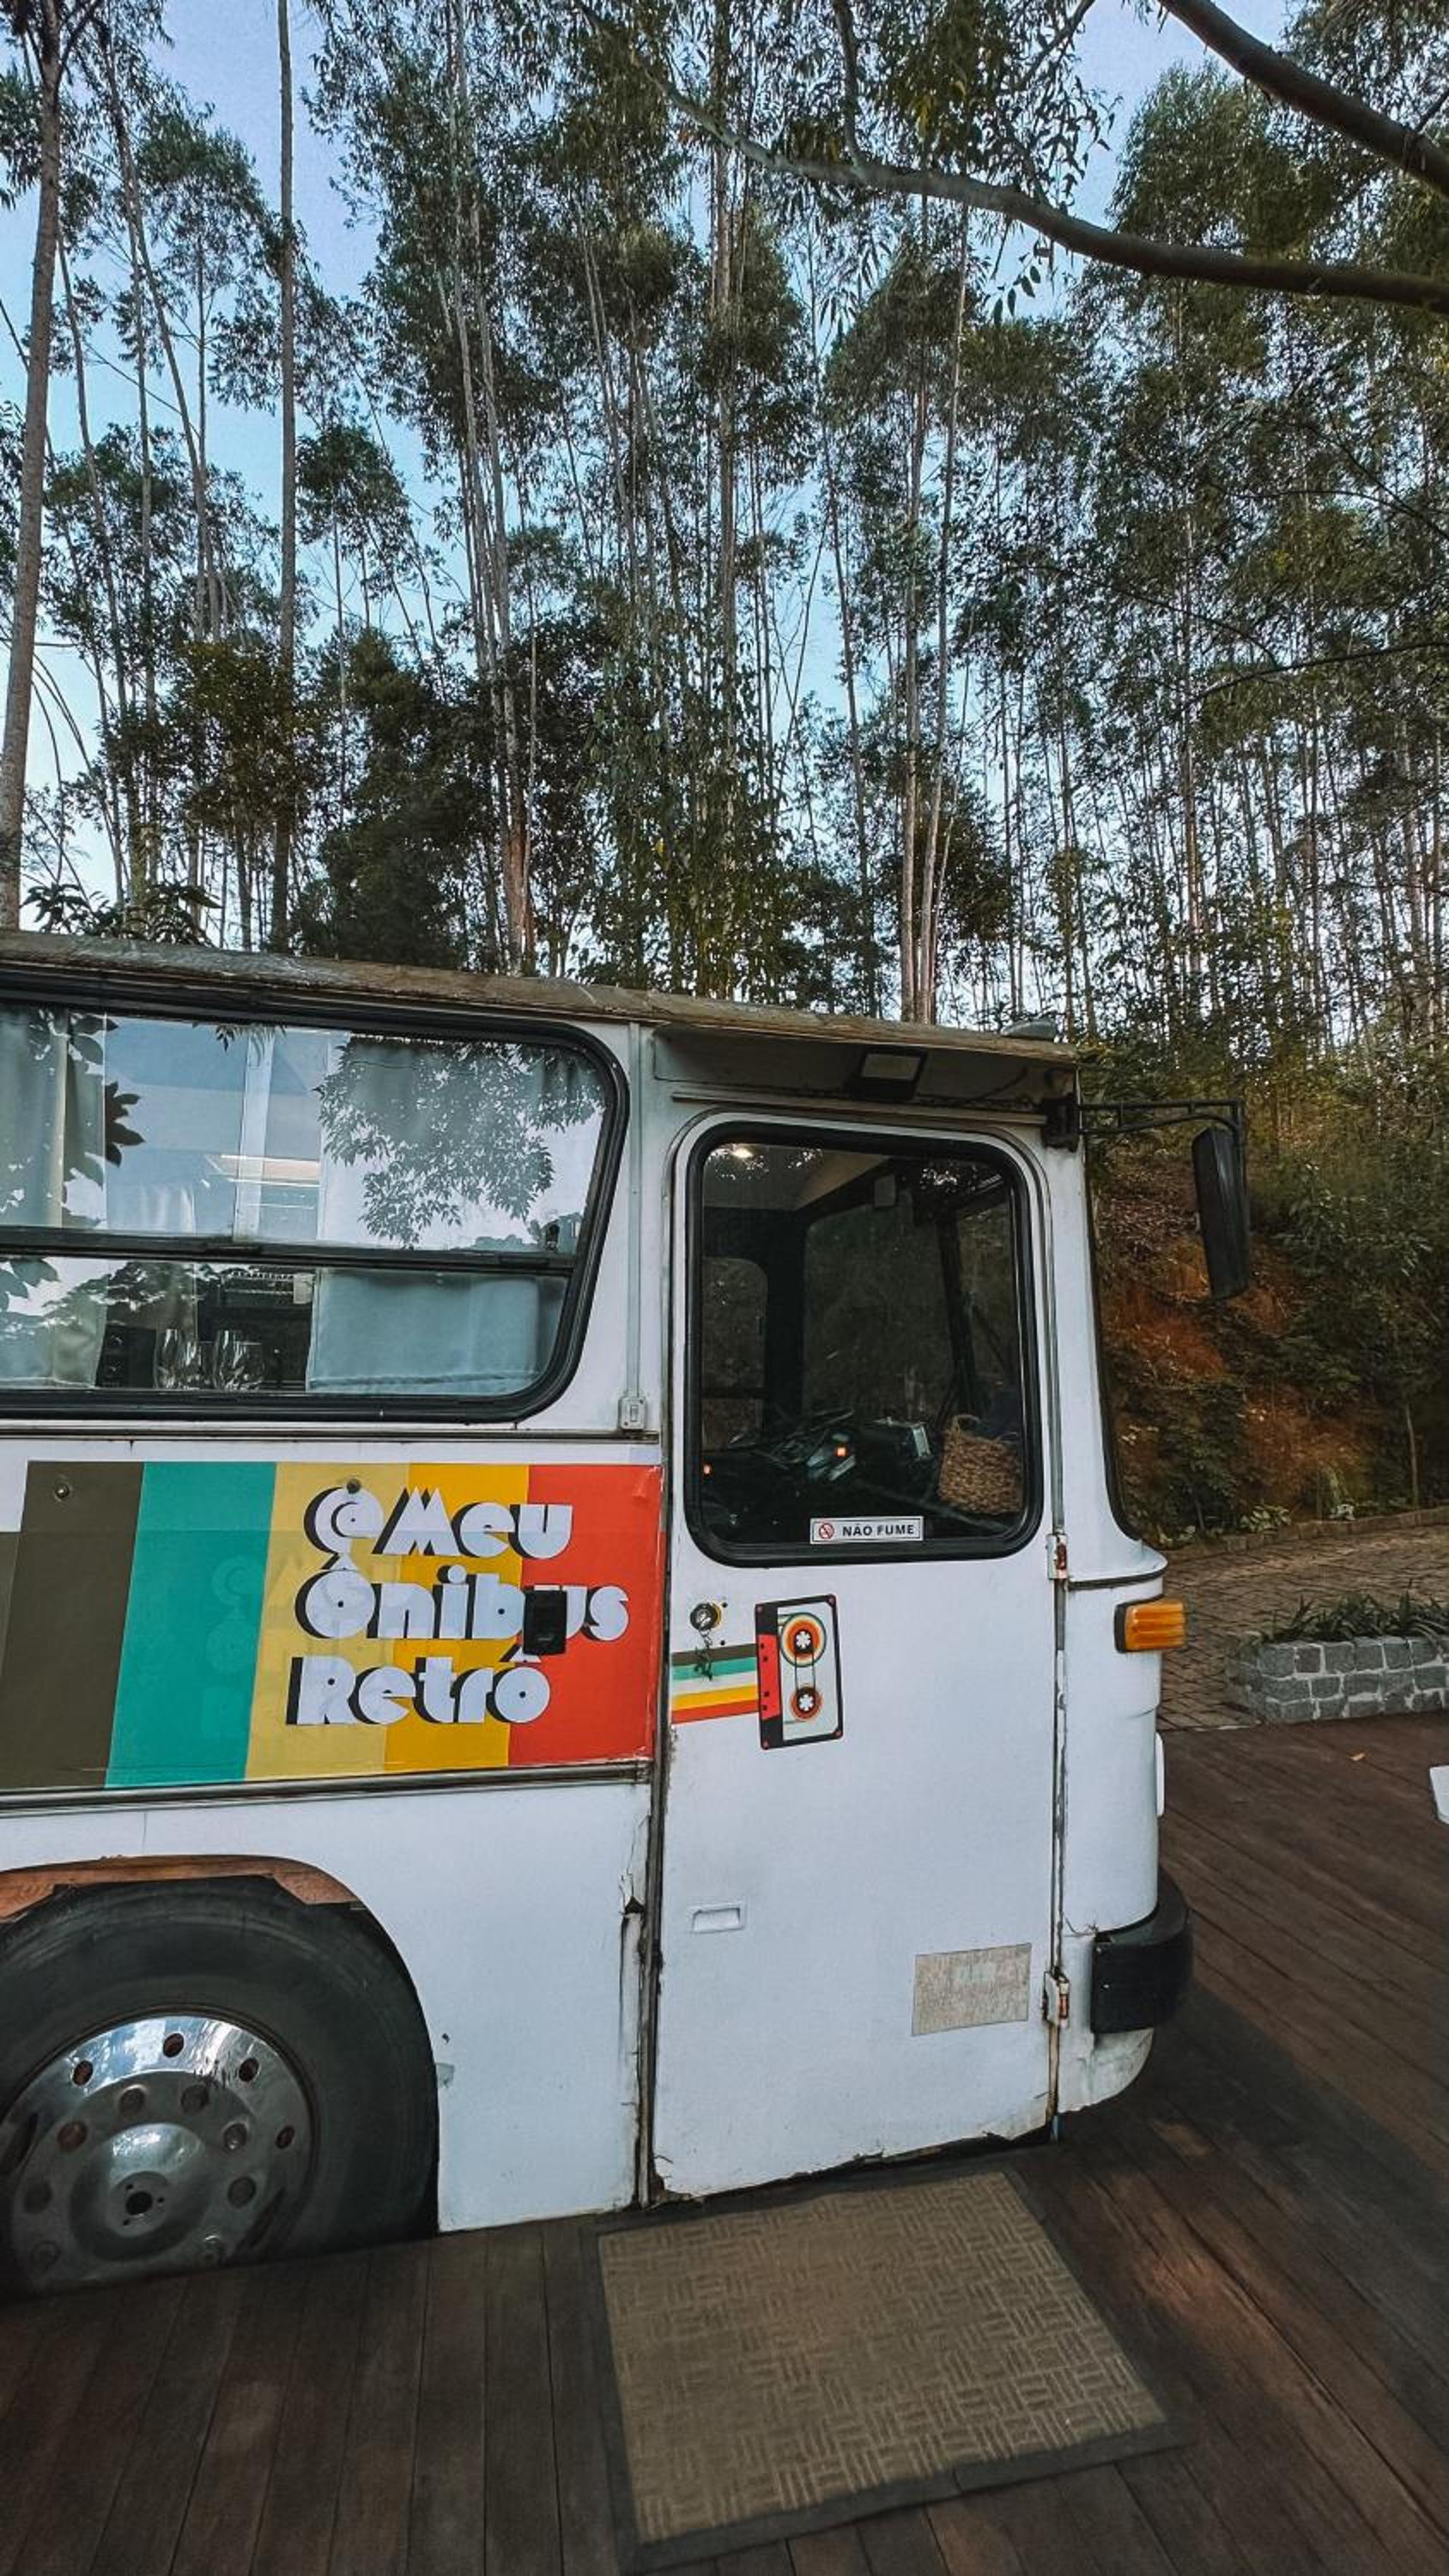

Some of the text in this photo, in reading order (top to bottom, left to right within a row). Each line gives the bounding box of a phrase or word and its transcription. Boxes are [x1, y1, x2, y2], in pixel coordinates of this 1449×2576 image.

[303, 1486, 573, 1559] @Meu
[842, 1523, 914, 1536] NÃO FUME
